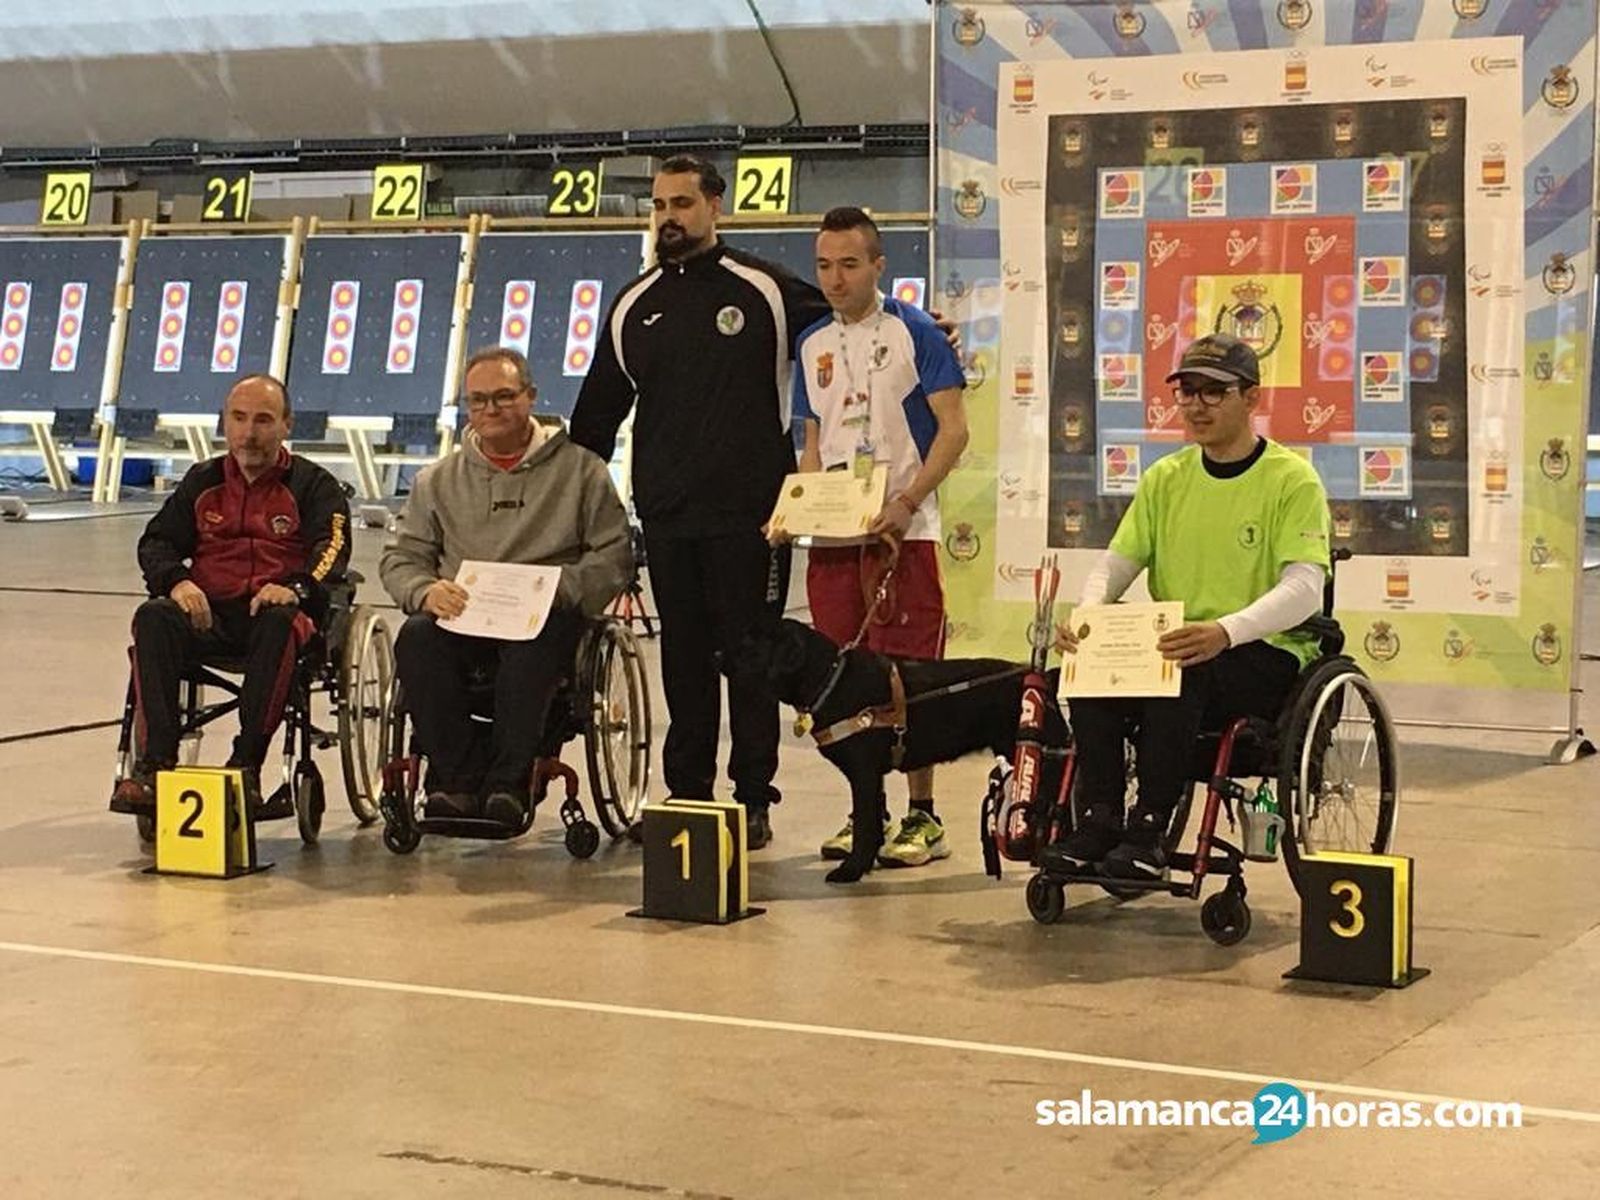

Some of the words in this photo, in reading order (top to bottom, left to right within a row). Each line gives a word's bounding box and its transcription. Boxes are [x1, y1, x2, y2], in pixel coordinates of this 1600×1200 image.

[47, 182, 85, 220] 20
[205, 177, 247, 219] 21
[377, 174, 417, 216] 22
[549, 170, 596, 214] 23
[738, 167, 785, 210] 24
[178, 789, 204, 838] 2
[671, 827, 690, 880] 1
[1329, 879, 1364, 938] 3
